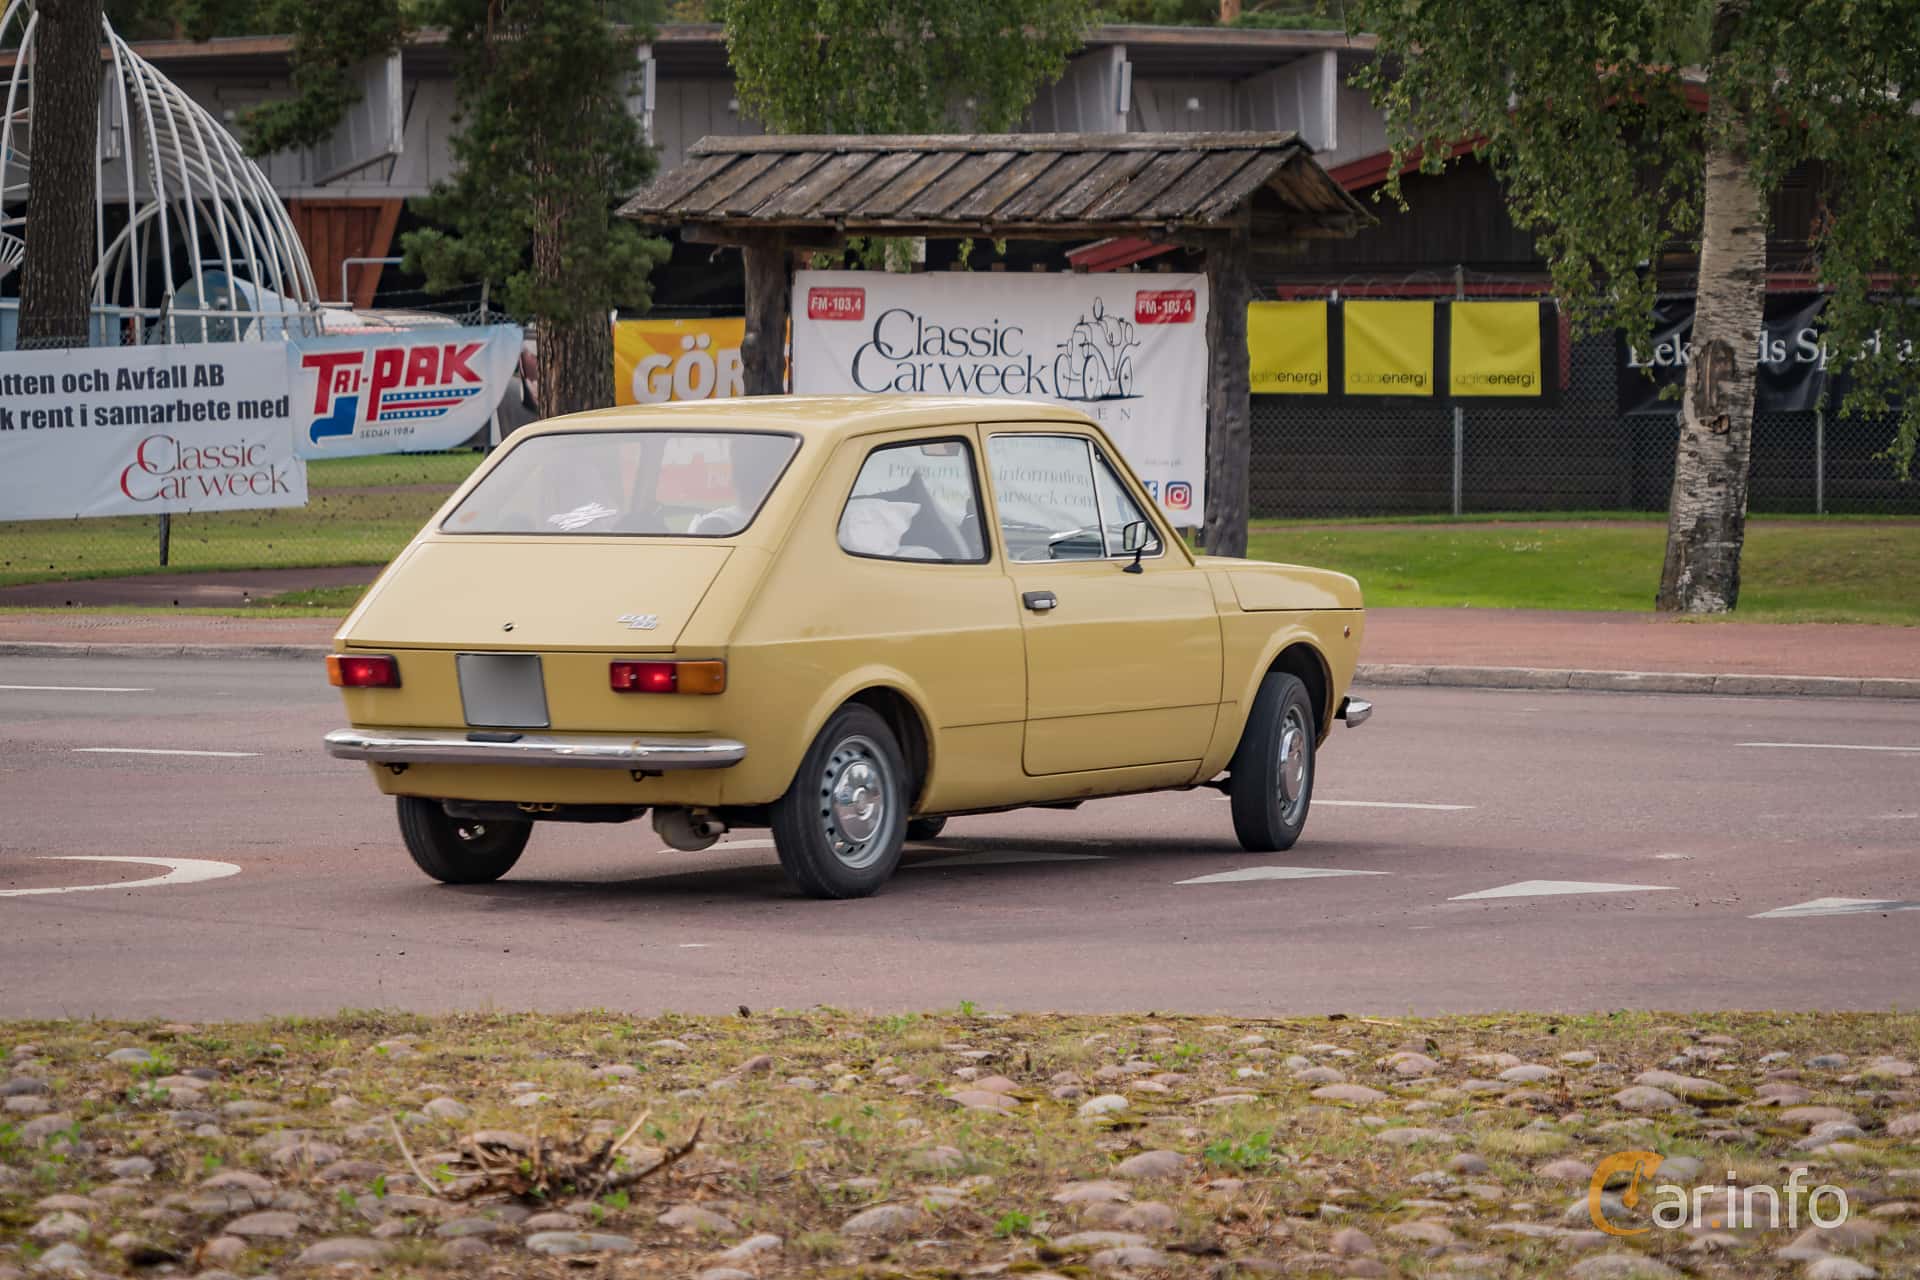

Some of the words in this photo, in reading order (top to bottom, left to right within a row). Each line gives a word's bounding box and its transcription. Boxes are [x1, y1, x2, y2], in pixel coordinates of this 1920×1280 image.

[873, 308, 1023, 360] Classic
[0, 373, 55, 396] tten
[62, 369, 110, 394] och
[115, 365, 187, 391] Avfall
[193, 363, 225, 388] AB
[20, 405, 75, 430] rent
[80, 404, 88, 427] i
[94, 399, 231, 426] samarbete
[237, 395, 289, 420] med
[137, 434, 266, 475] Classic
